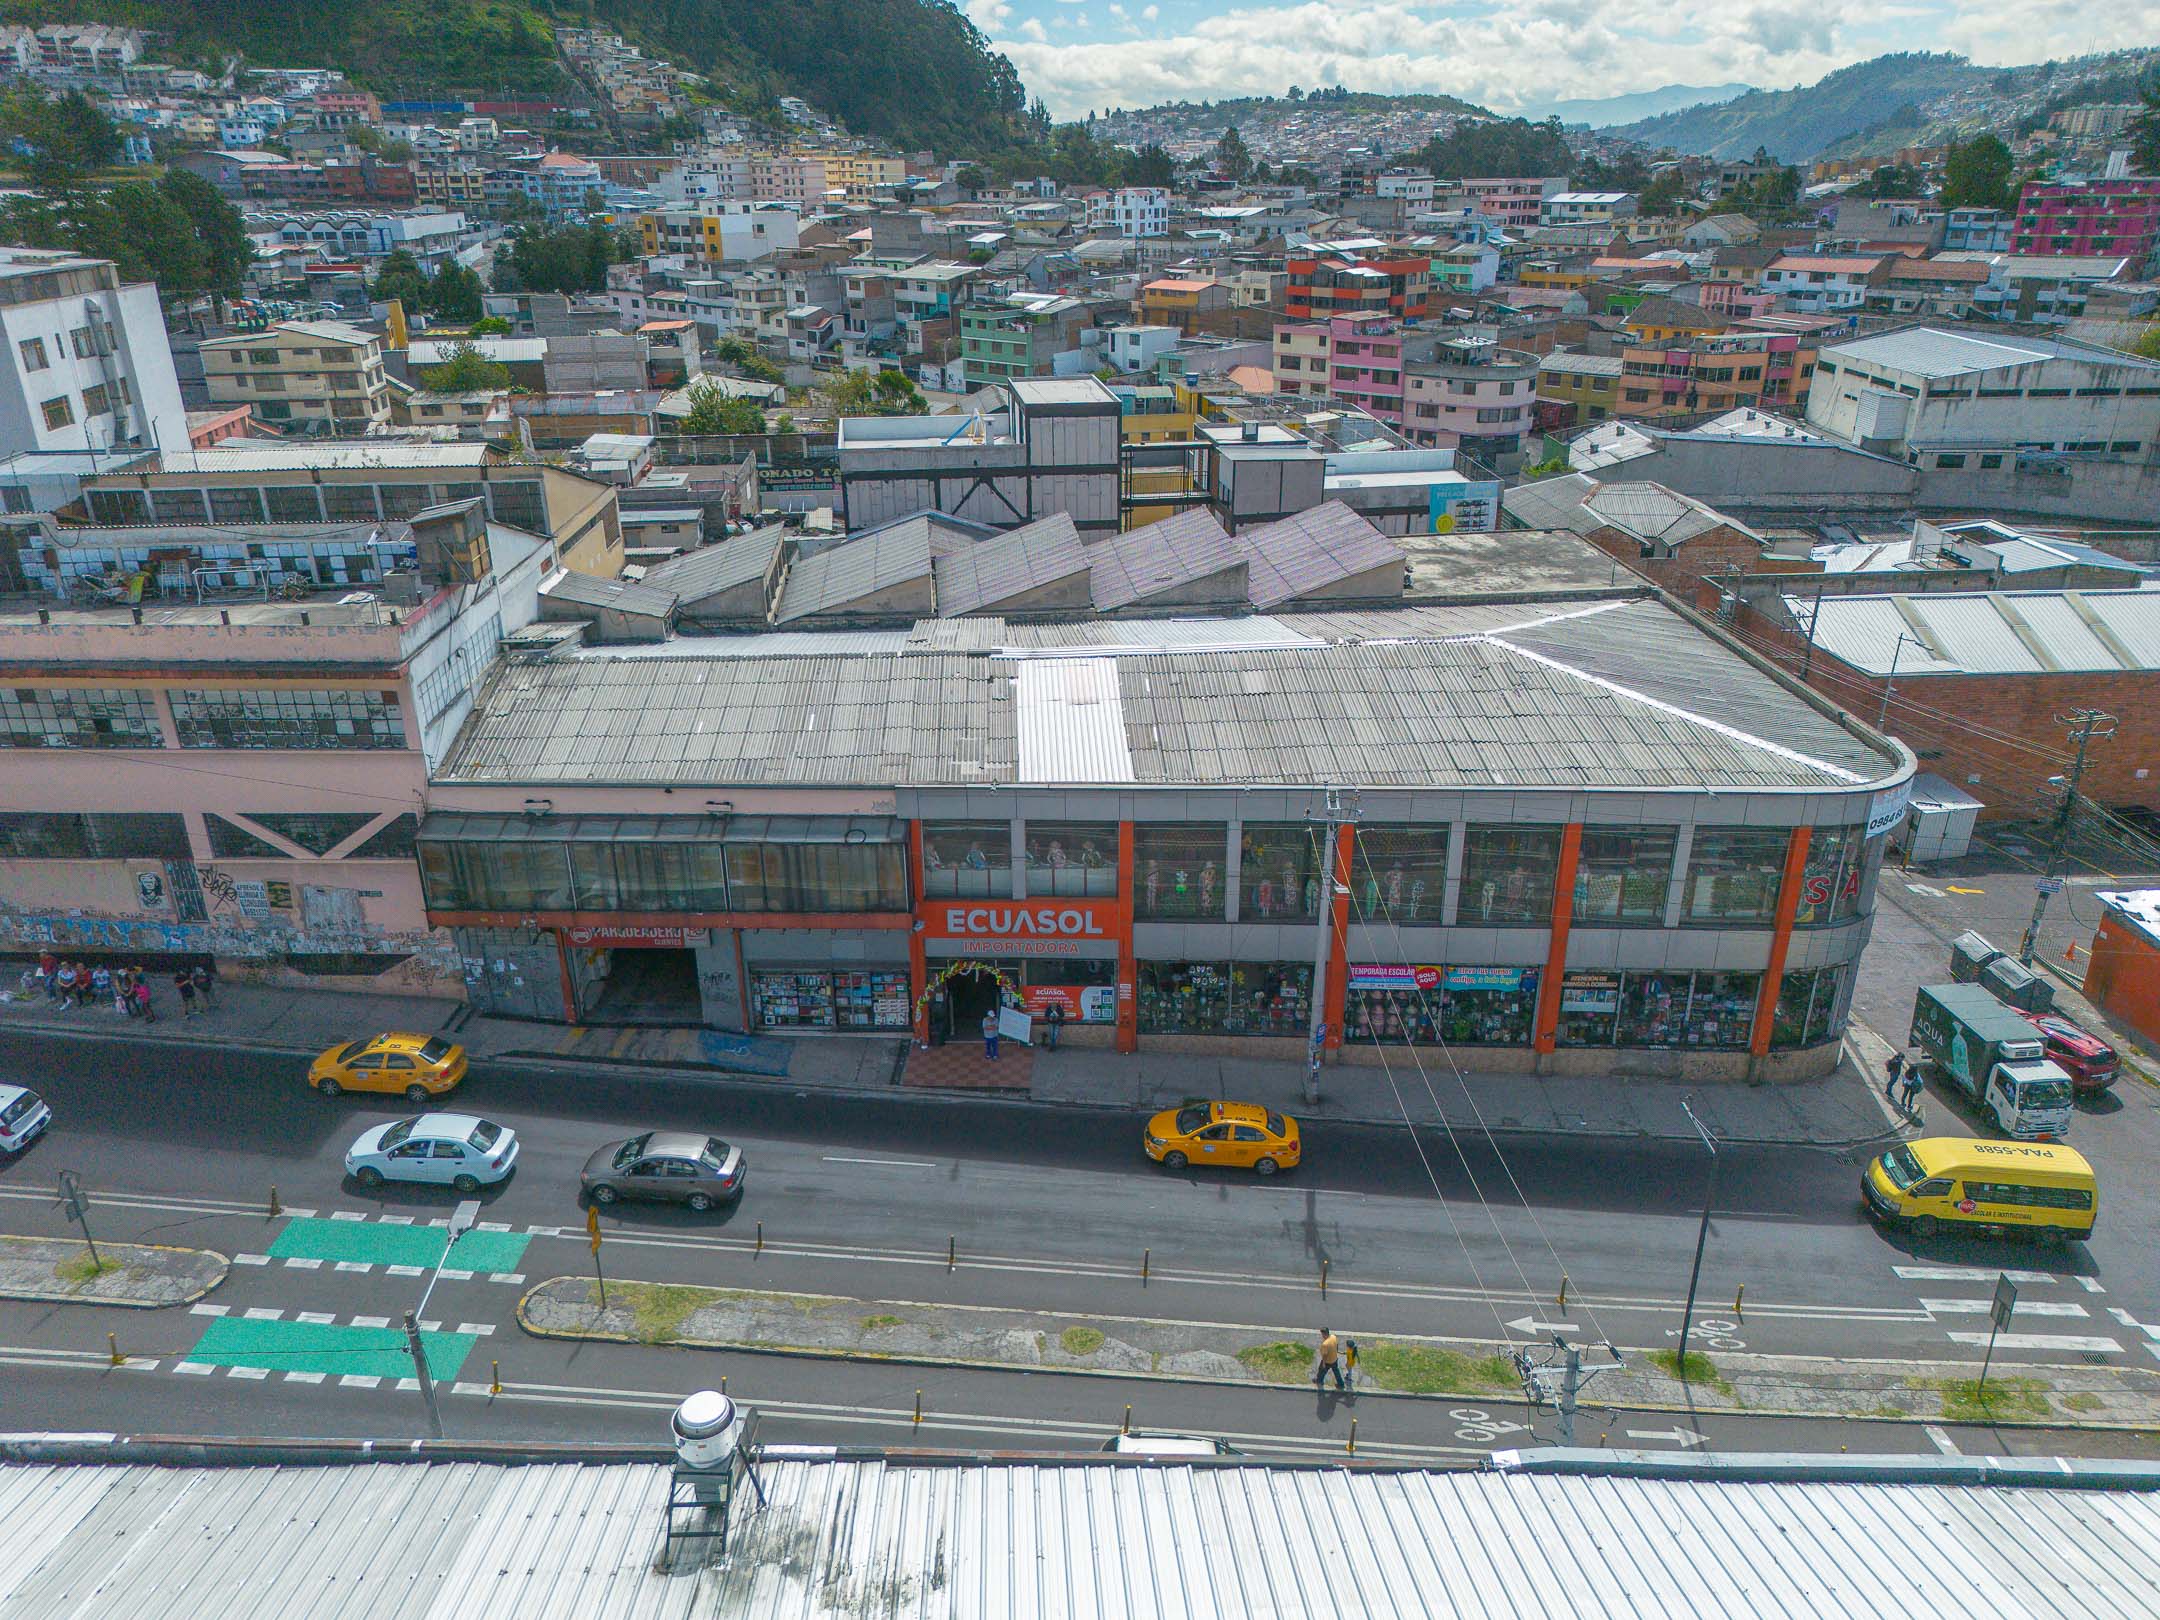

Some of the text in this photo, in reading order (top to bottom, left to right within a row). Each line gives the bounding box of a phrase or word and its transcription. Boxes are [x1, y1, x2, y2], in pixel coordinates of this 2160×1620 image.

[946, 909, 1103, 935] ECUASOL
[963, 941, 1080, 954] IMPORTADORA
[1351, 967, 1416, 976] TEMPORADA ESCOLAR
[1917, 1018, 1944, 1047] AQUA
[1974, 1144, 2054, 1158] PAA-5588
